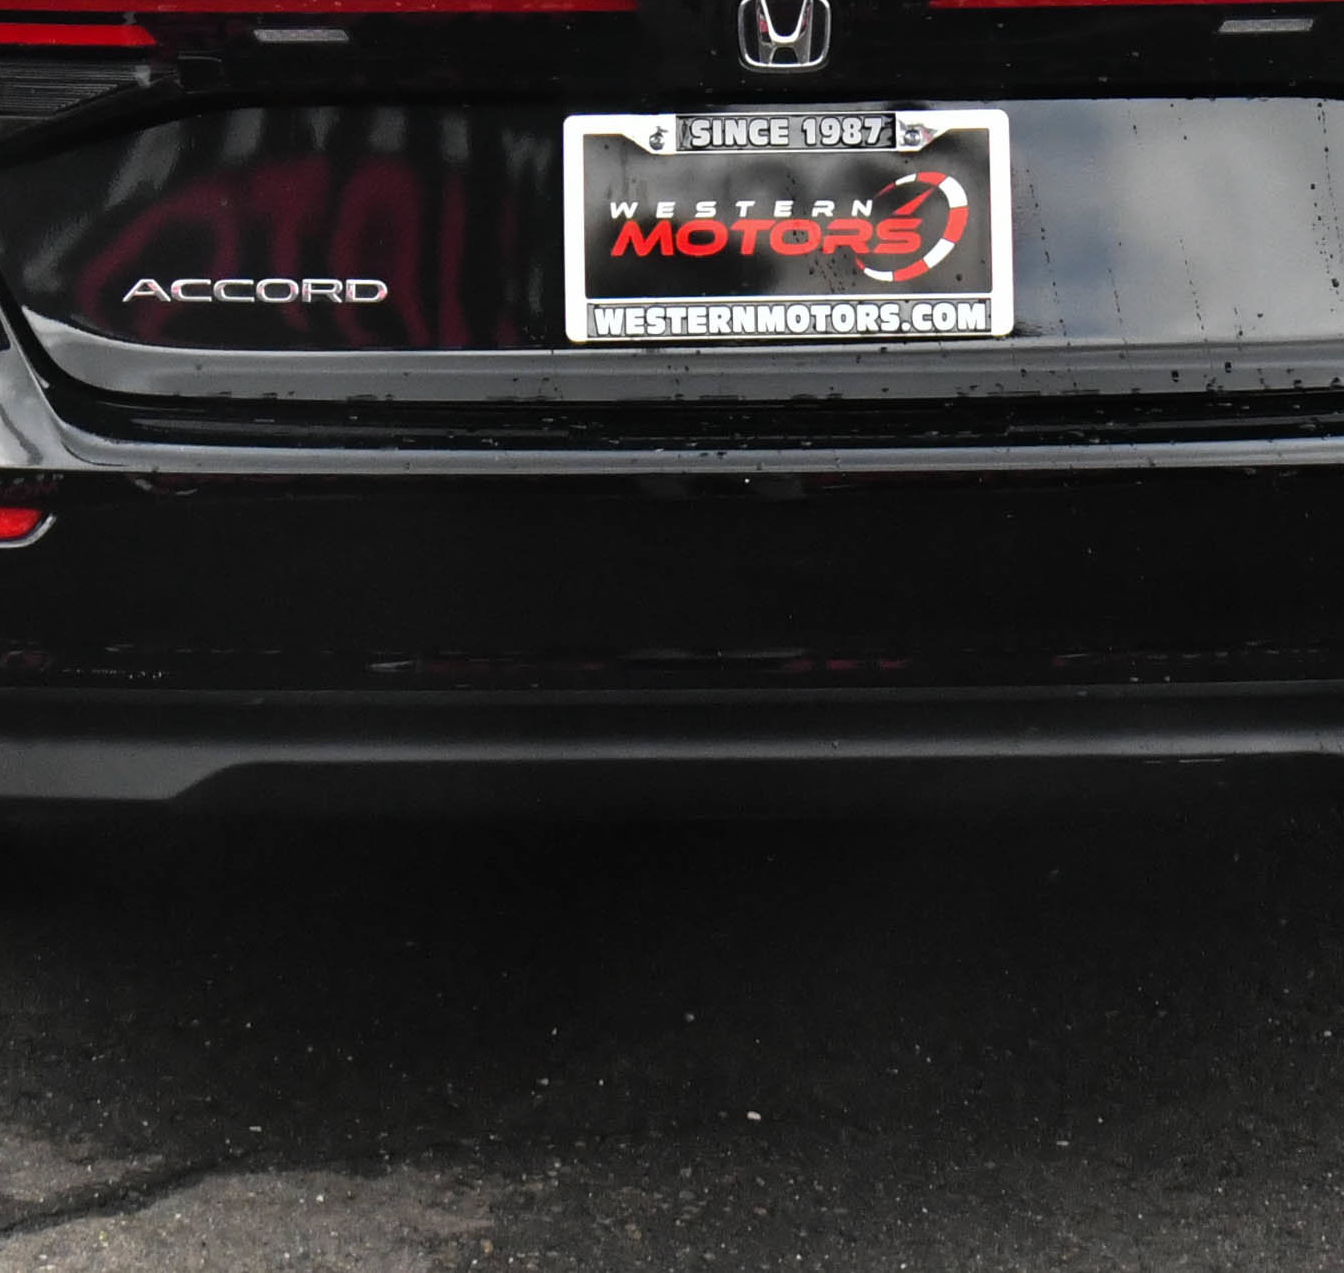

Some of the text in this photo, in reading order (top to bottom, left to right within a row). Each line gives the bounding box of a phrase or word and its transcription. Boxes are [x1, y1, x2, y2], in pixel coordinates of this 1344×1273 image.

[690, 117, 883, 147] SINCE 1987
[610, 199, 873, 219] WESTERN
[610, 217, 923, 257] MOTORS
[122, 278, 388, 303] ACCORD
[593, 302, 988, 336] WESTERNMOTORS.COM
